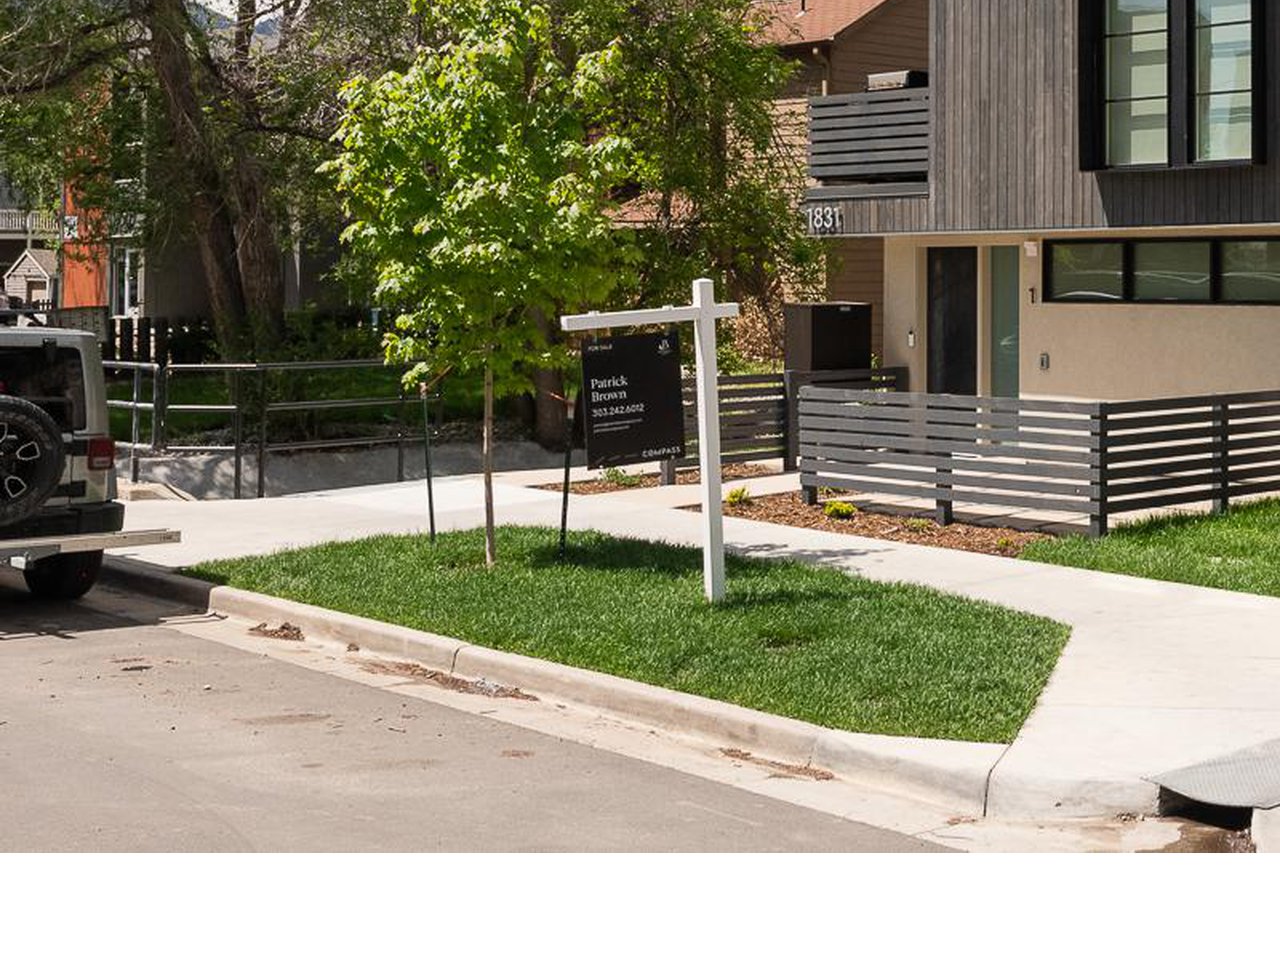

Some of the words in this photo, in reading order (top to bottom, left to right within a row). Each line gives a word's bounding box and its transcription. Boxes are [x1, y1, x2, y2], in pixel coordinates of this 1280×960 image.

[807, 206, 840, 228] 1831
[591, 375, 628, 389] Patrick
[592, 390, 627, 402] Brown
[641, 446, 681, 457] COMPASS
